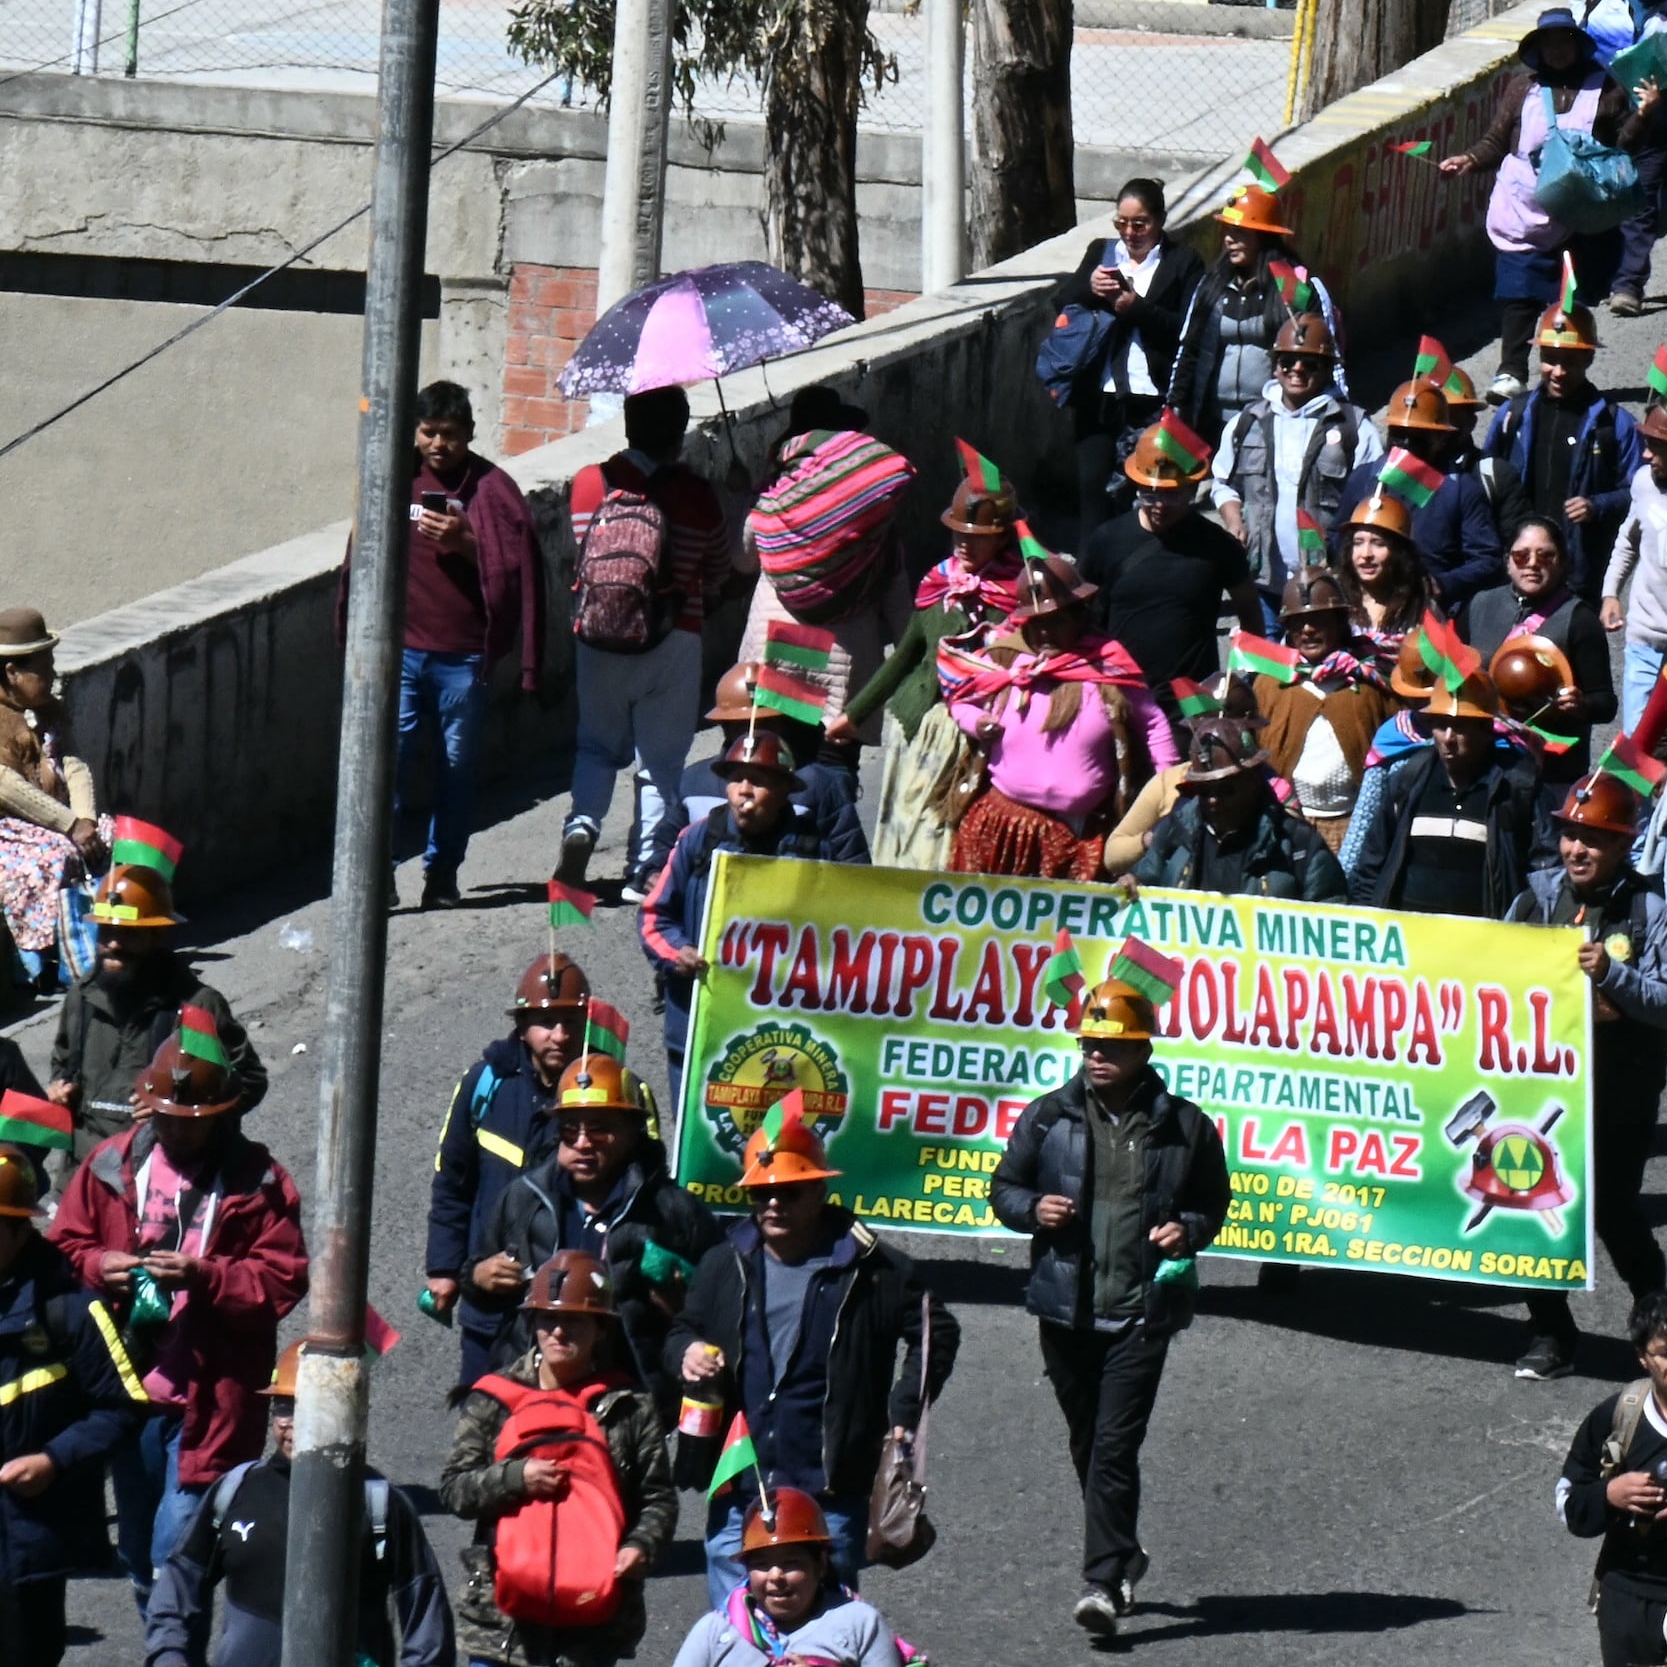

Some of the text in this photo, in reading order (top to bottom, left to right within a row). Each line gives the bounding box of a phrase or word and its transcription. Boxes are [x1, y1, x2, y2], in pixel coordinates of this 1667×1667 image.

[922, 883, 1407, 967] COOPERATIVA MINERA
[718, 1030, 839, 1091] COOPERATIVA MINERA
[1478, 987, 1576, 1076] R.L.
[707, 1085, 761, 1104] TAMIPLAYA
[882, 1038, 1420, 1122] FEDERACI DEPARTAMENTAL
[718, 1111, 734, 1134] LA
[1241, 1120, 1308, 1166] LA
[1329, 1129, 1420, 1178] PAZ
[918, 1147, 1386, 1209] FUND AYO DE 2017
[923, 1174, 993, 1200] PERS
[1289, 1203, 1374, 1234] PJ061
[853, 1197, 1003, 1227] LARECAJ
[1213, 1220, 1276, 1251] IÑIJO
[1282, 1232, 1337, 1258] 1RA.
[1346, 1240, 1472, 1272] SECCION
[1479, 1252, 1587, 1282] SORATA
